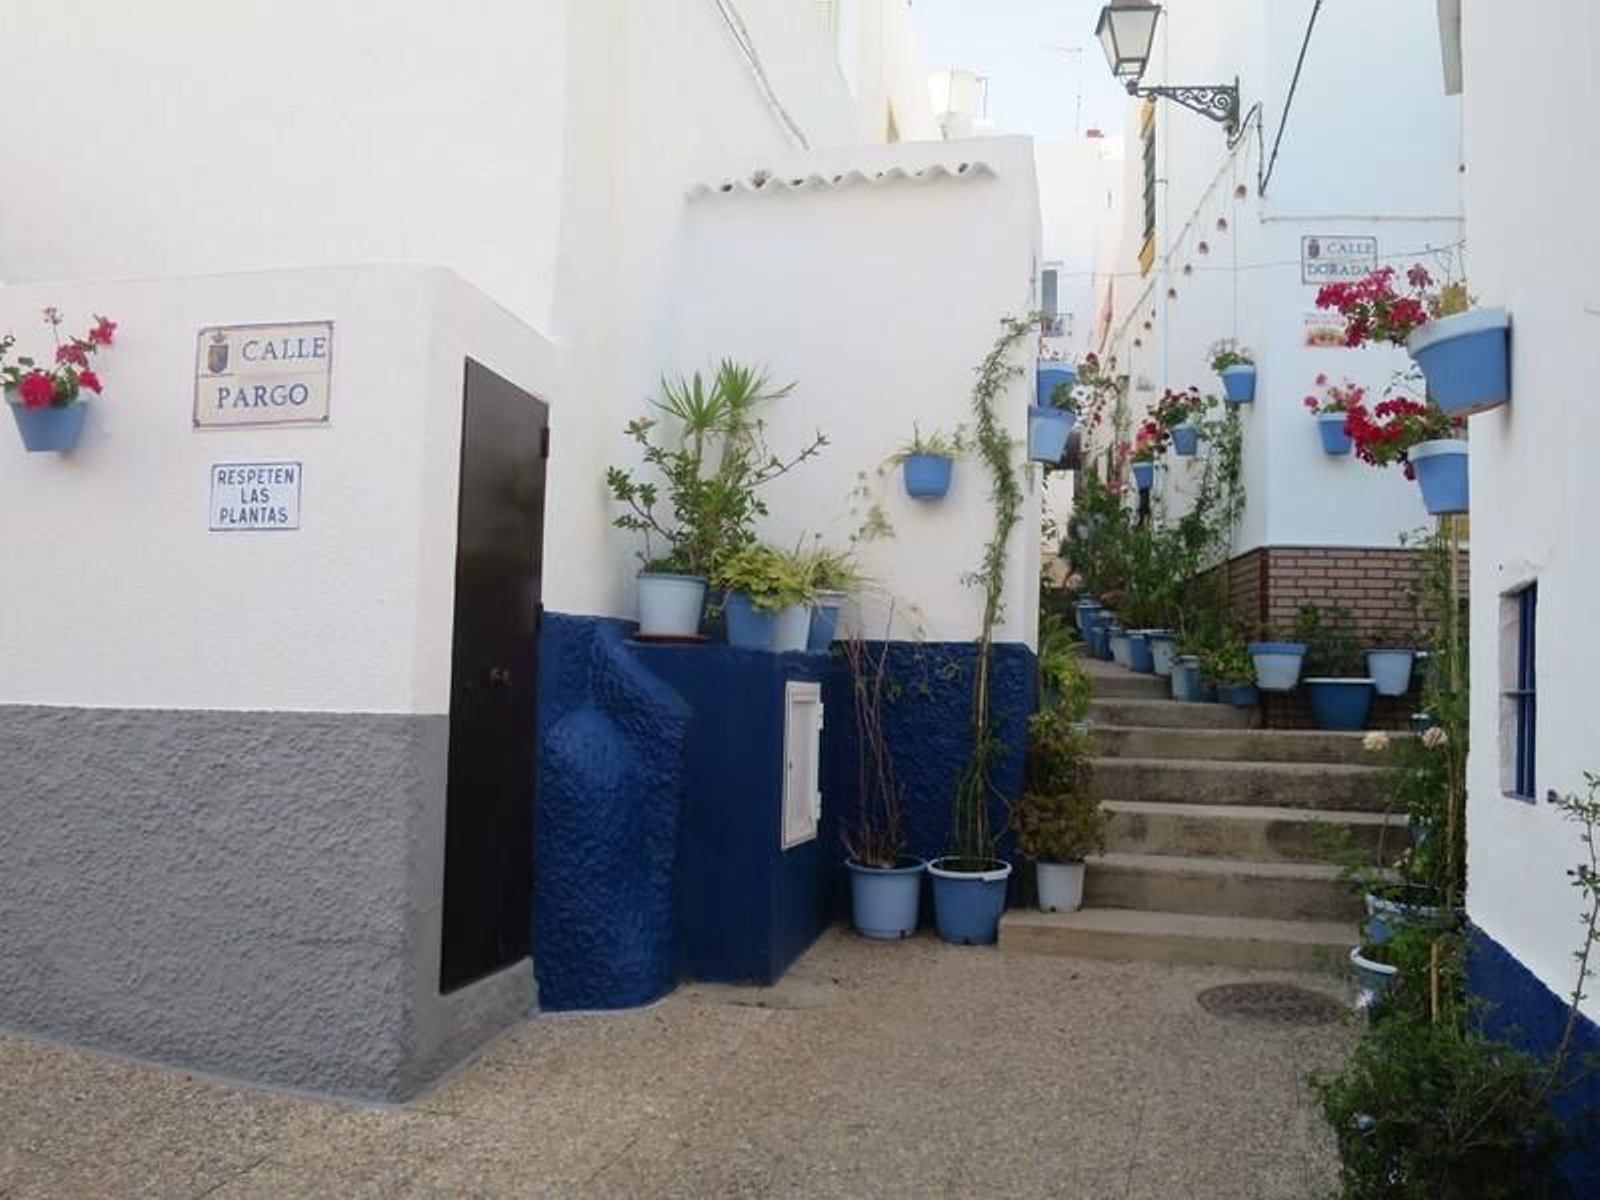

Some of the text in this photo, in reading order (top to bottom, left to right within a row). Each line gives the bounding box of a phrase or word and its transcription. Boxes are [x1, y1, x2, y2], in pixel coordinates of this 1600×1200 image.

[1327, 241, 1375, 255] CALLE
[242, 336, 326, 362] CALLE
[216, 383, 309, 409] PARGO
[217, 468, 295, 485] RESPETEN
[241, 487, 270, 504] LAS
[219, 506, 289, 525] PLANTAS
